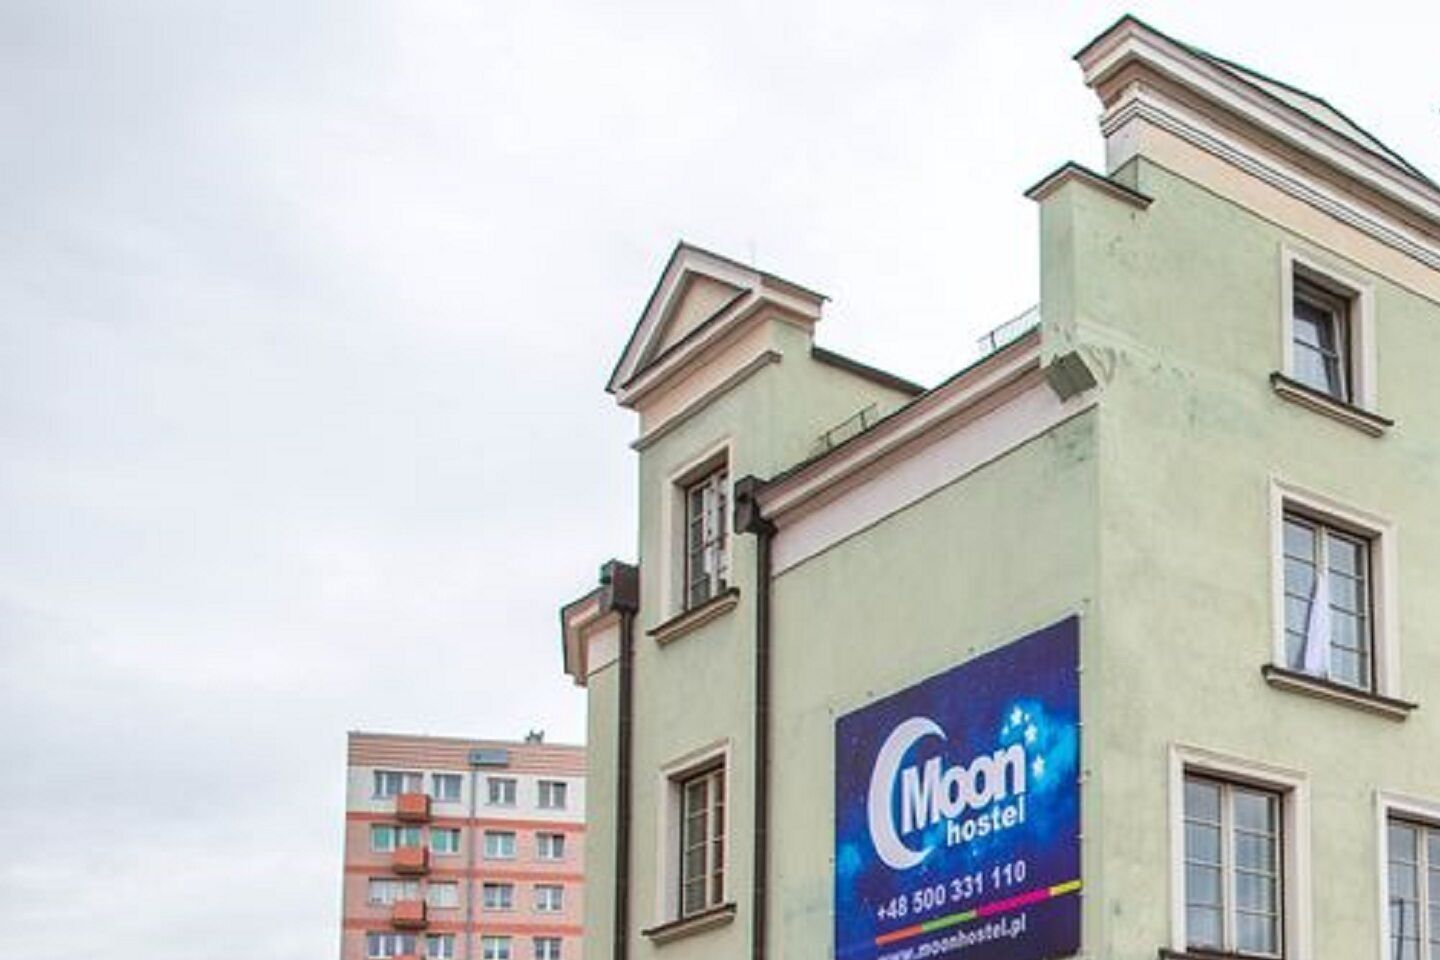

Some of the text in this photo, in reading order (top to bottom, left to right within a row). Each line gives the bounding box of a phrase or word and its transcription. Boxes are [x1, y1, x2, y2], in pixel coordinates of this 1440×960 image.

[900, 743, 1026, 835] Moon
[946, 796, 1026, 848] hostel
[877, 860, 1026, 920] +48 500 331 110
